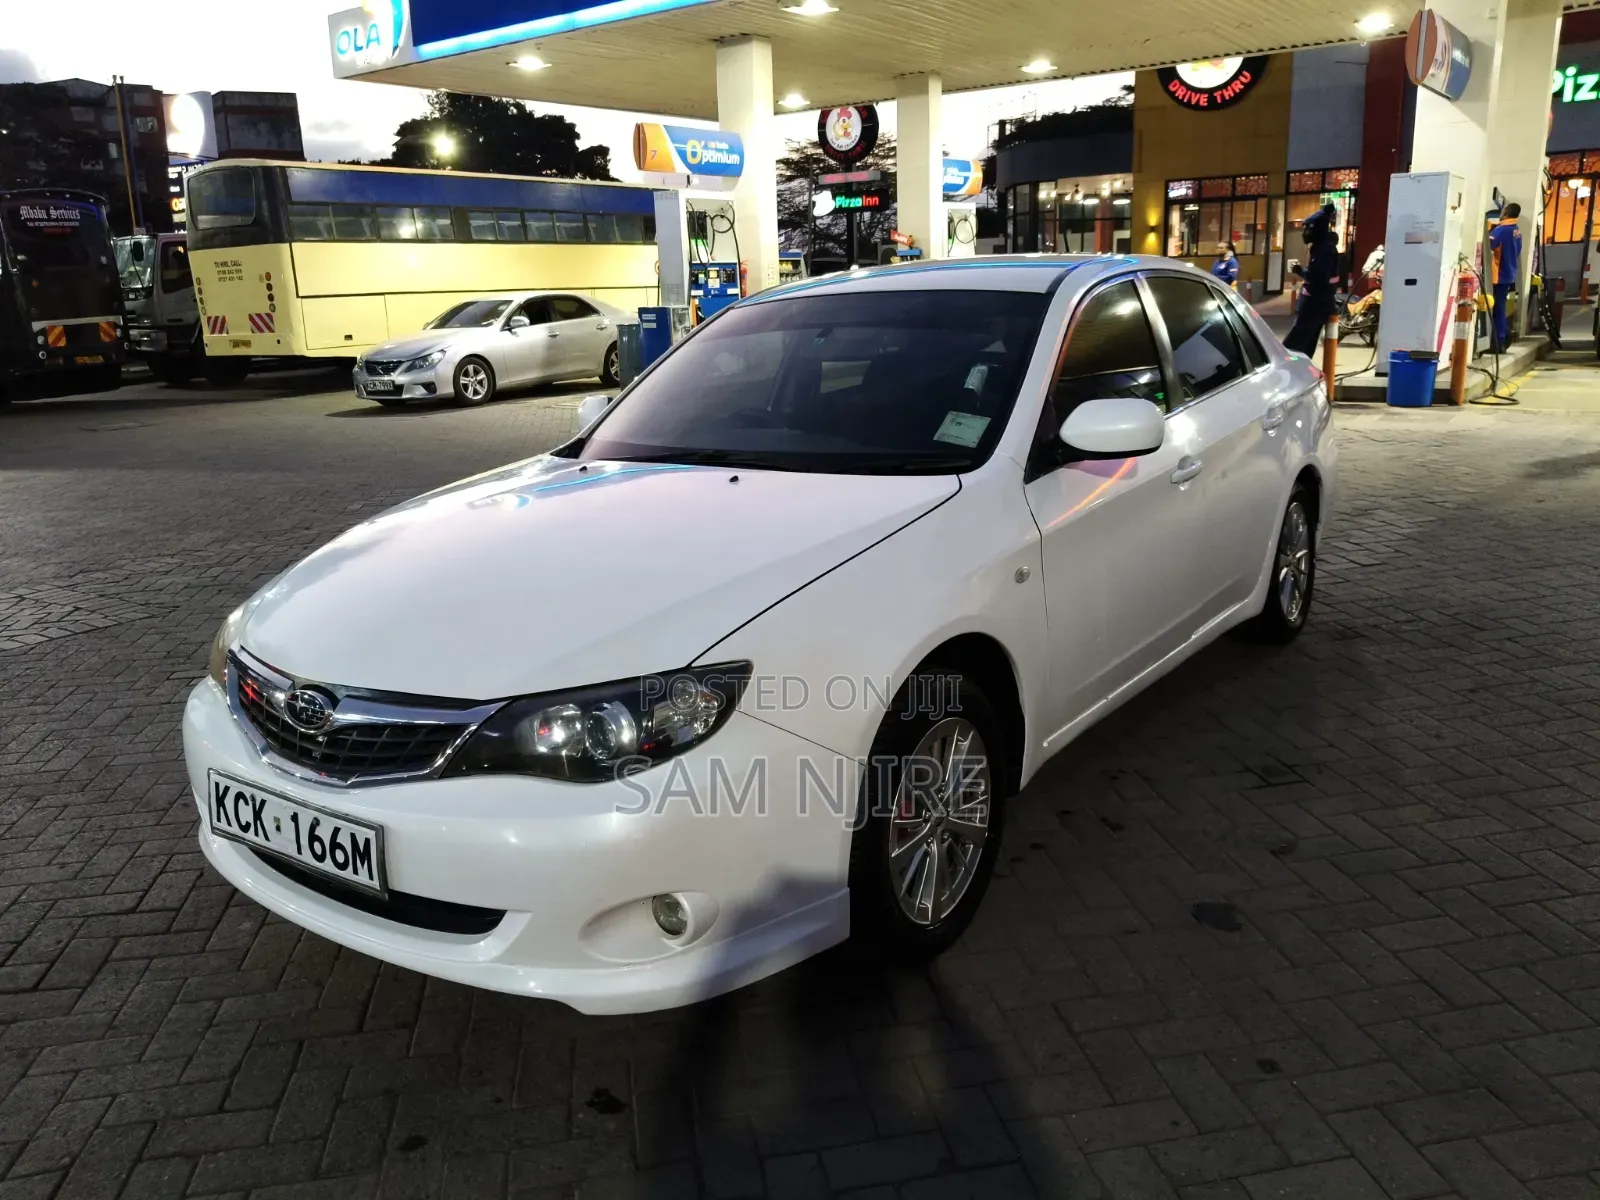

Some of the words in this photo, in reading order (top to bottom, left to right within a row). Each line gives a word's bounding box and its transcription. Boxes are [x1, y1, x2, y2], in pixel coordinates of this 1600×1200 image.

[336, 23, 381, 55] OLA
[1168, 79, 1209, 107] DRIVE
[1213, 70, 1252, 104] THRU
[650, 150, 657, 160] 7
[49, 205, 80, 219] Services
[214, 781, 271, 843] KCK
[290, 811, 375, 882] 166M
